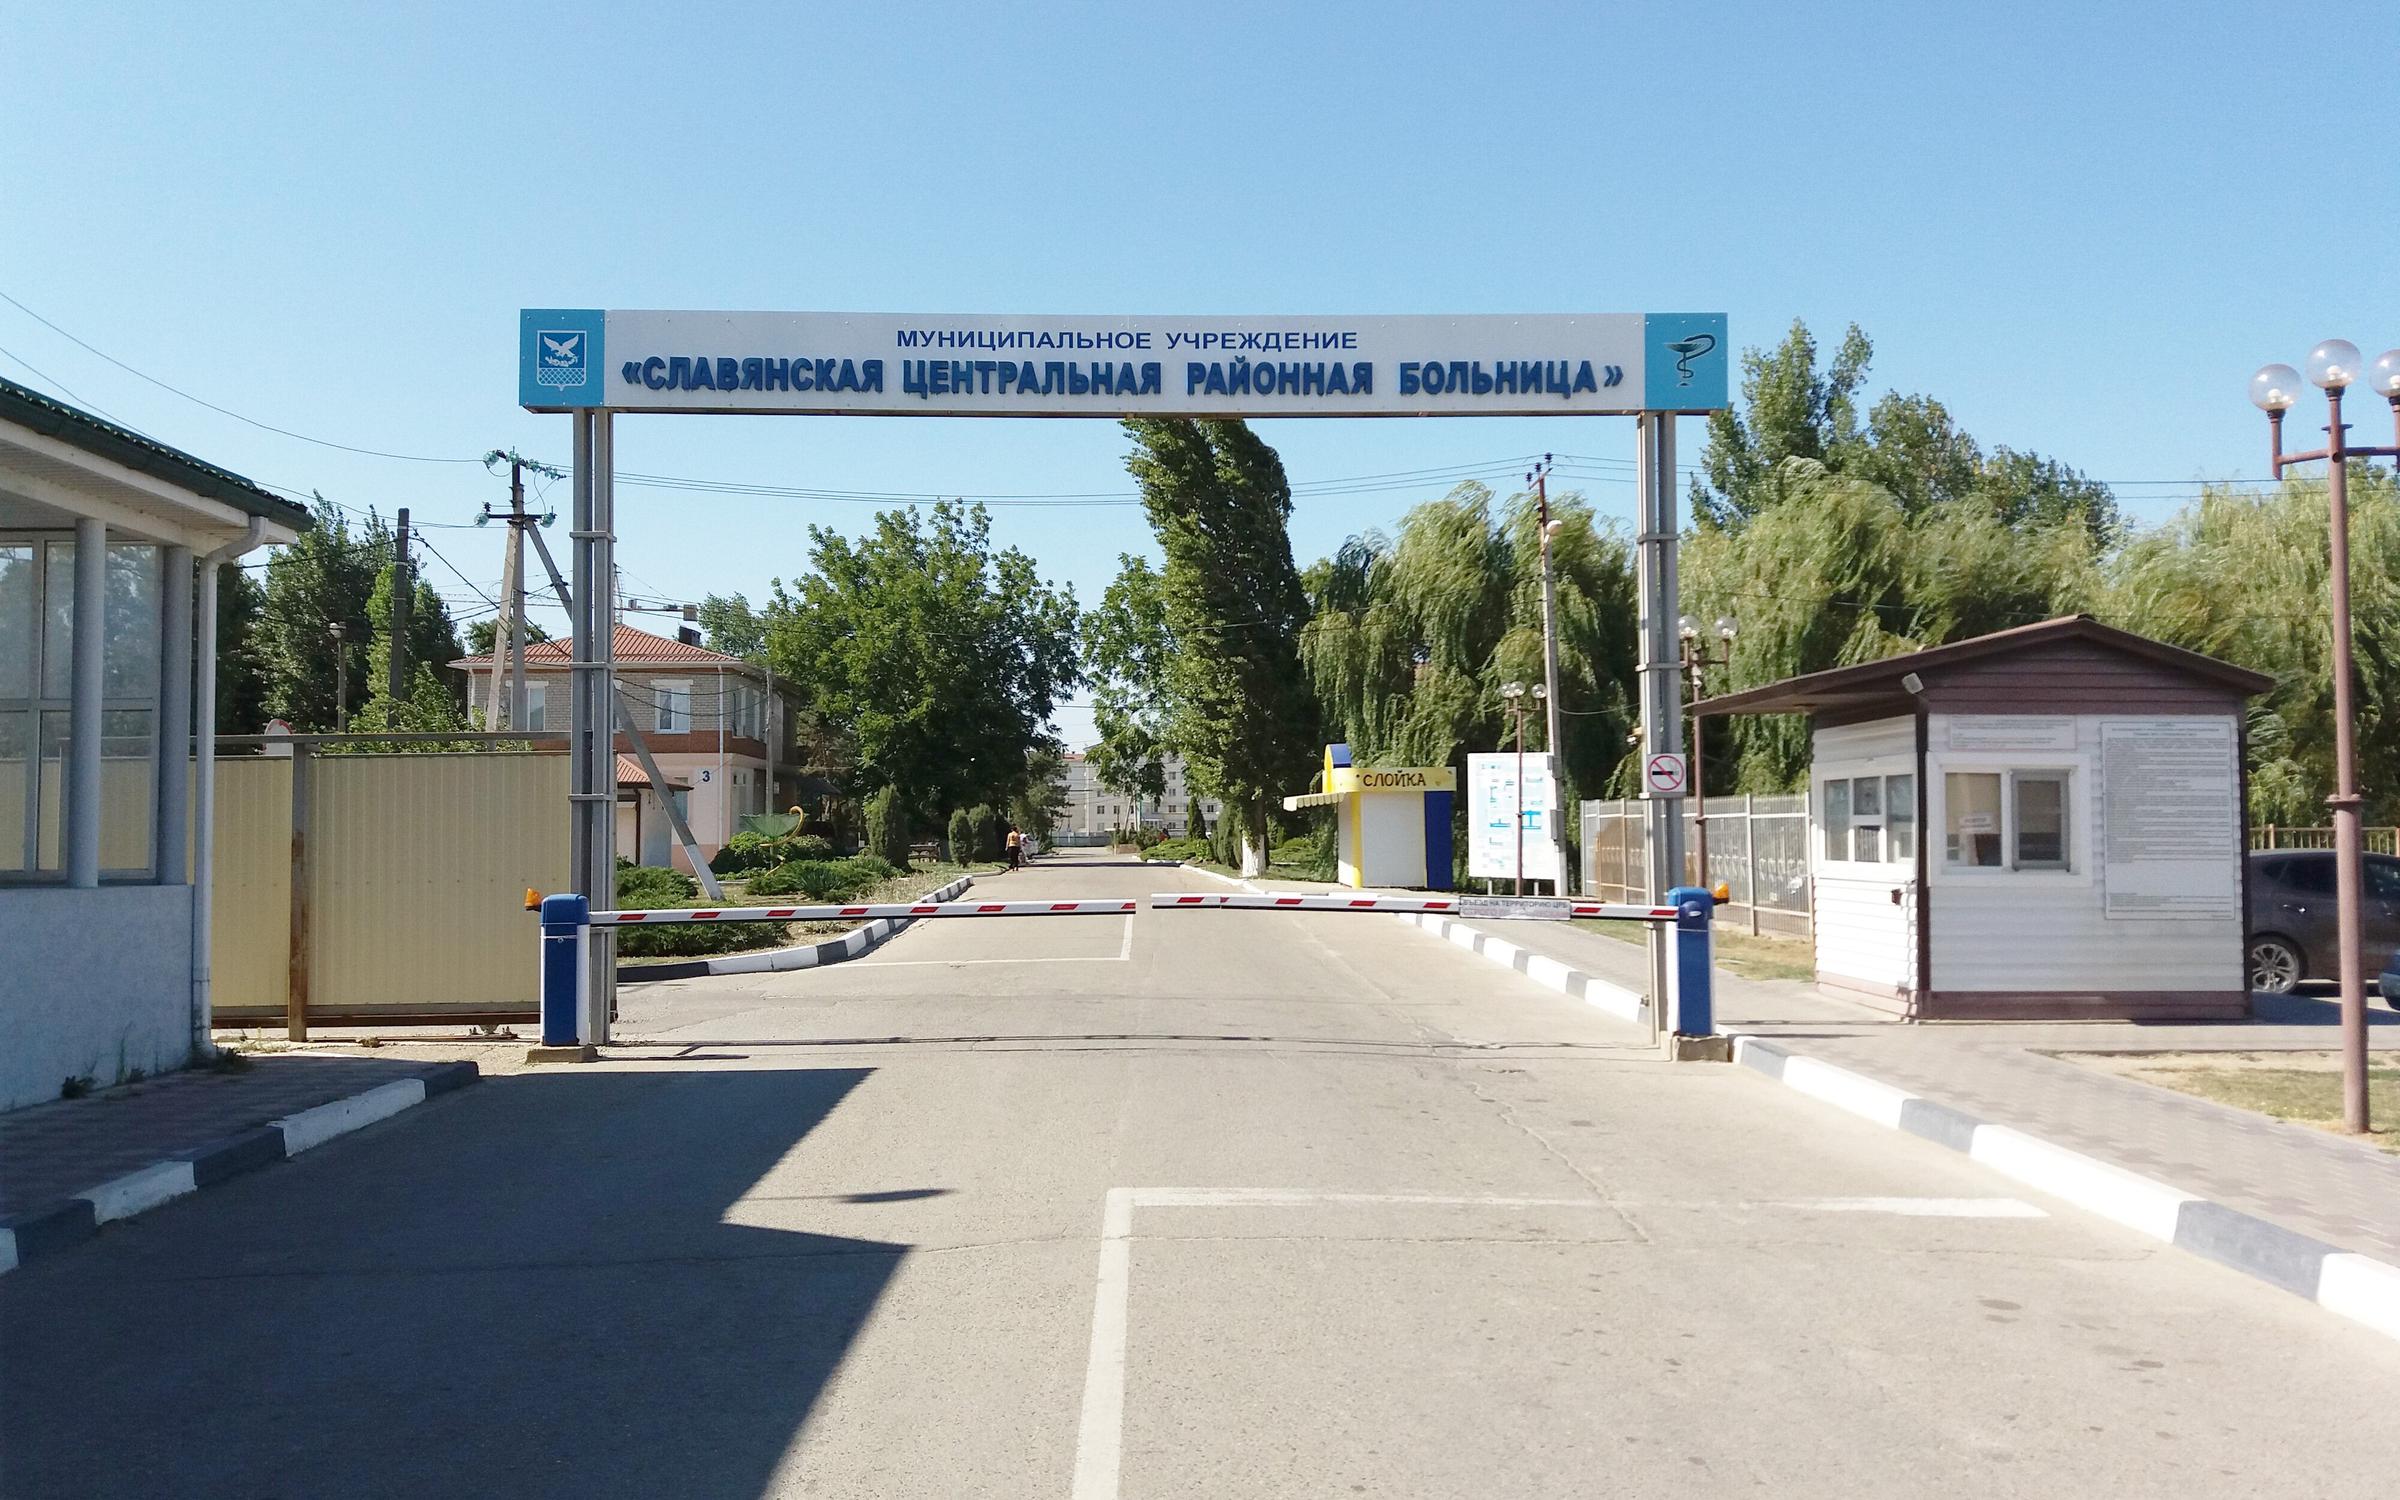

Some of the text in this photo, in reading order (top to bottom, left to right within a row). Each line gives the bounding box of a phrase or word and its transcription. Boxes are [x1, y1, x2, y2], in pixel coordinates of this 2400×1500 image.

[896, 329, 1358, 352] МУНИЦИПАЛЬНОЕ УЧРЕЖДЕНИЕ
[621, 355, 1624, 400] «СЛАВЯНСКАЯ ЦЕНТРАЛЬНАЯ РАЙОННАЯ БОЛЬНИЦА»
[702, 770, 710, 782] 3
[1363, 769, 1426, 787] СЛОЙКА
